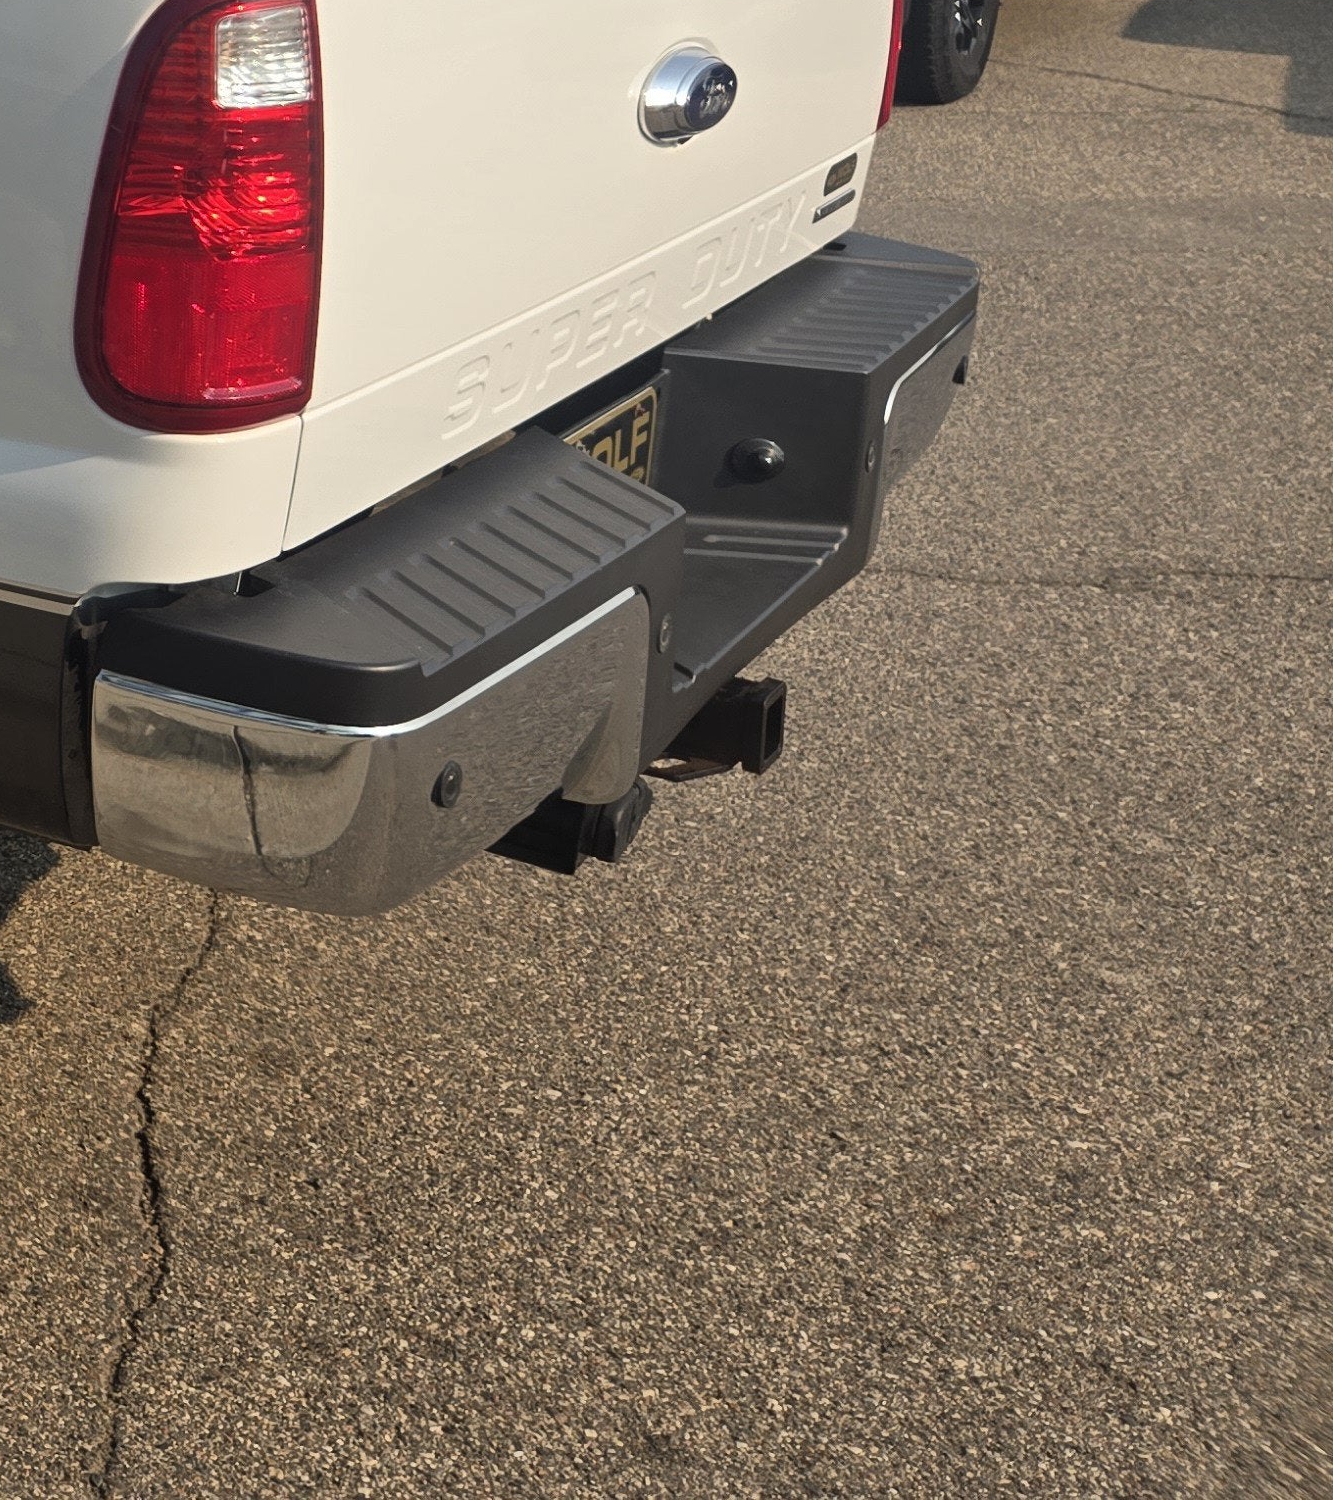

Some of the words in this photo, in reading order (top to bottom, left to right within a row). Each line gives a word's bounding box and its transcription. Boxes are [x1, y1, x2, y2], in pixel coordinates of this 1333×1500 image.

[441, 269, 669, 440] SUPER
[681, 188, 820, 310] DUTY
[592, 411, 651, 473] OLF
